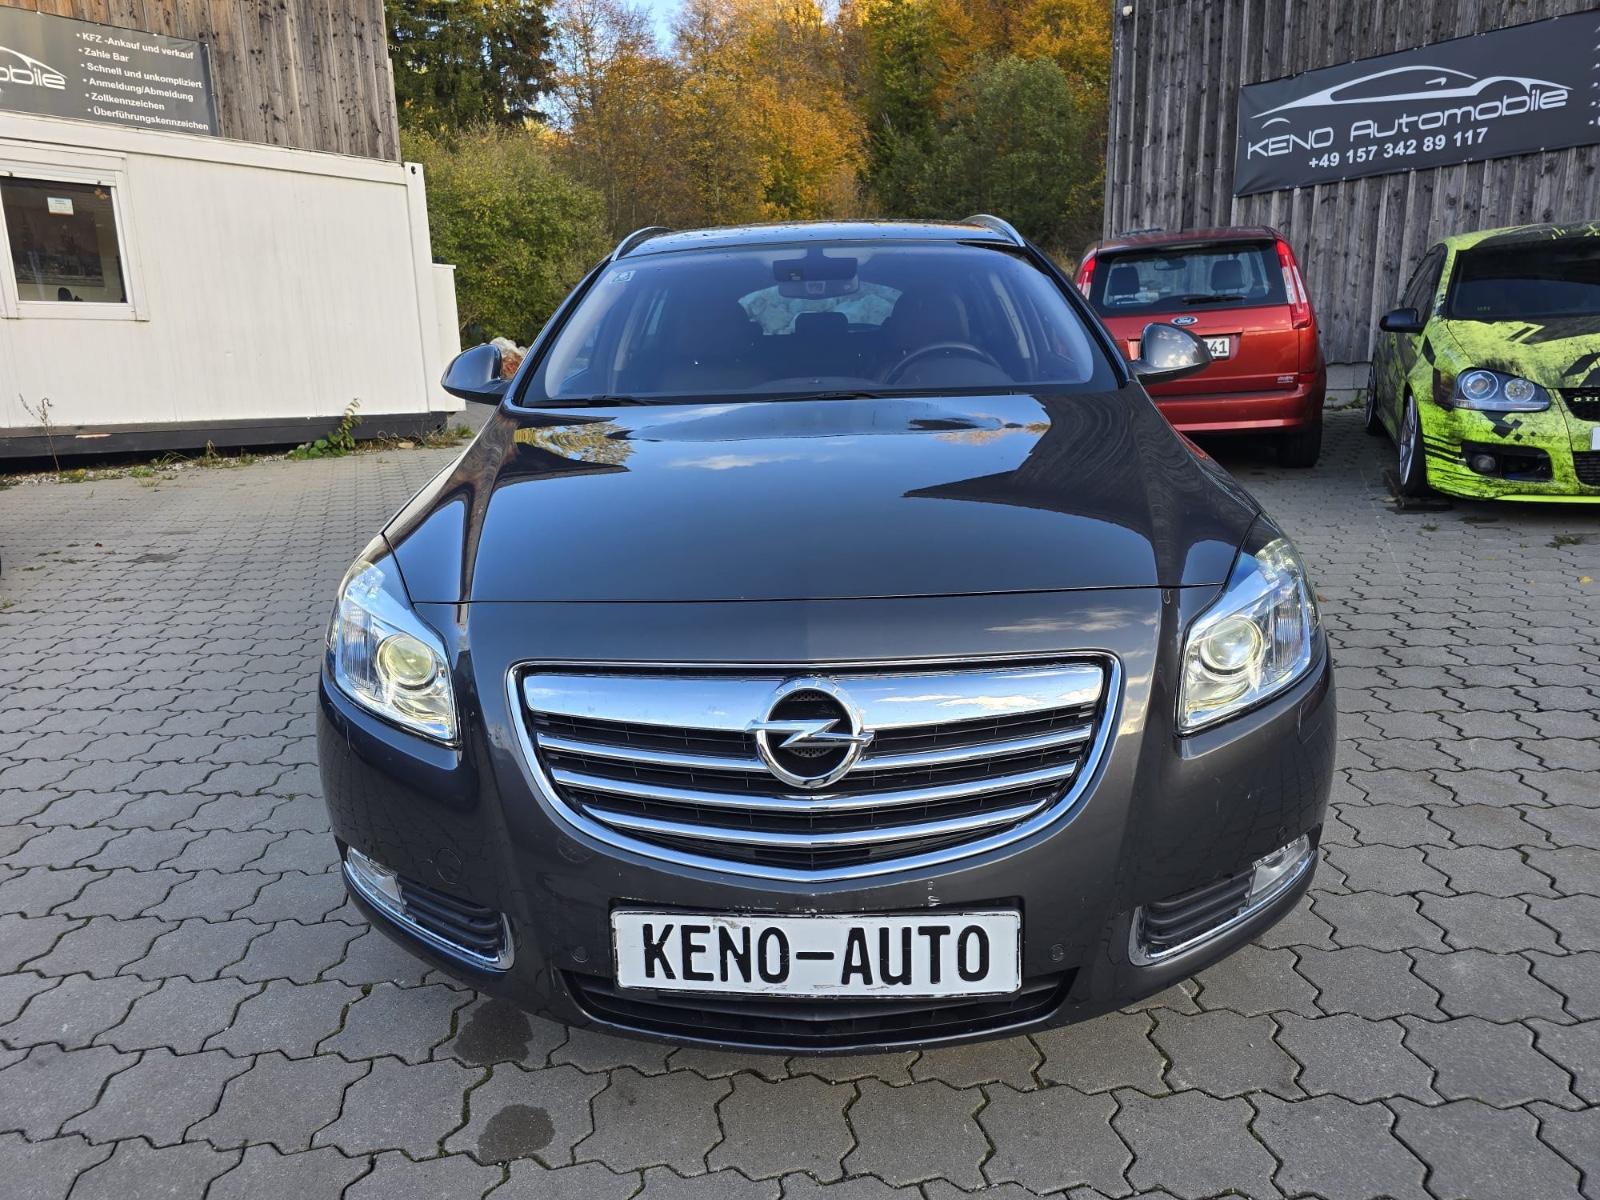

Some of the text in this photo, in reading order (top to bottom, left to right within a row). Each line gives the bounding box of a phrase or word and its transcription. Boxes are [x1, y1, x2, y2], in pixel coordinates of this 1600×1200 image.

[82, 33, 194, 59] KFZ -Ankauf und verkauf
[84, 48, 129, 62] Zahle Bar
[87, 63, 203, 88] Schnell und unkompliziert
[89, 78, 194, 102] Anmeldung/Abmeldung
[91, 93, 165, 110] Zollkennzeichen
[93, 106, 209, 130] Überführungskennzeichen
[1247, 89, 1569, 160] KENO Automobile
[1308, 127, 1488, 168] +49 157 342 89 117
